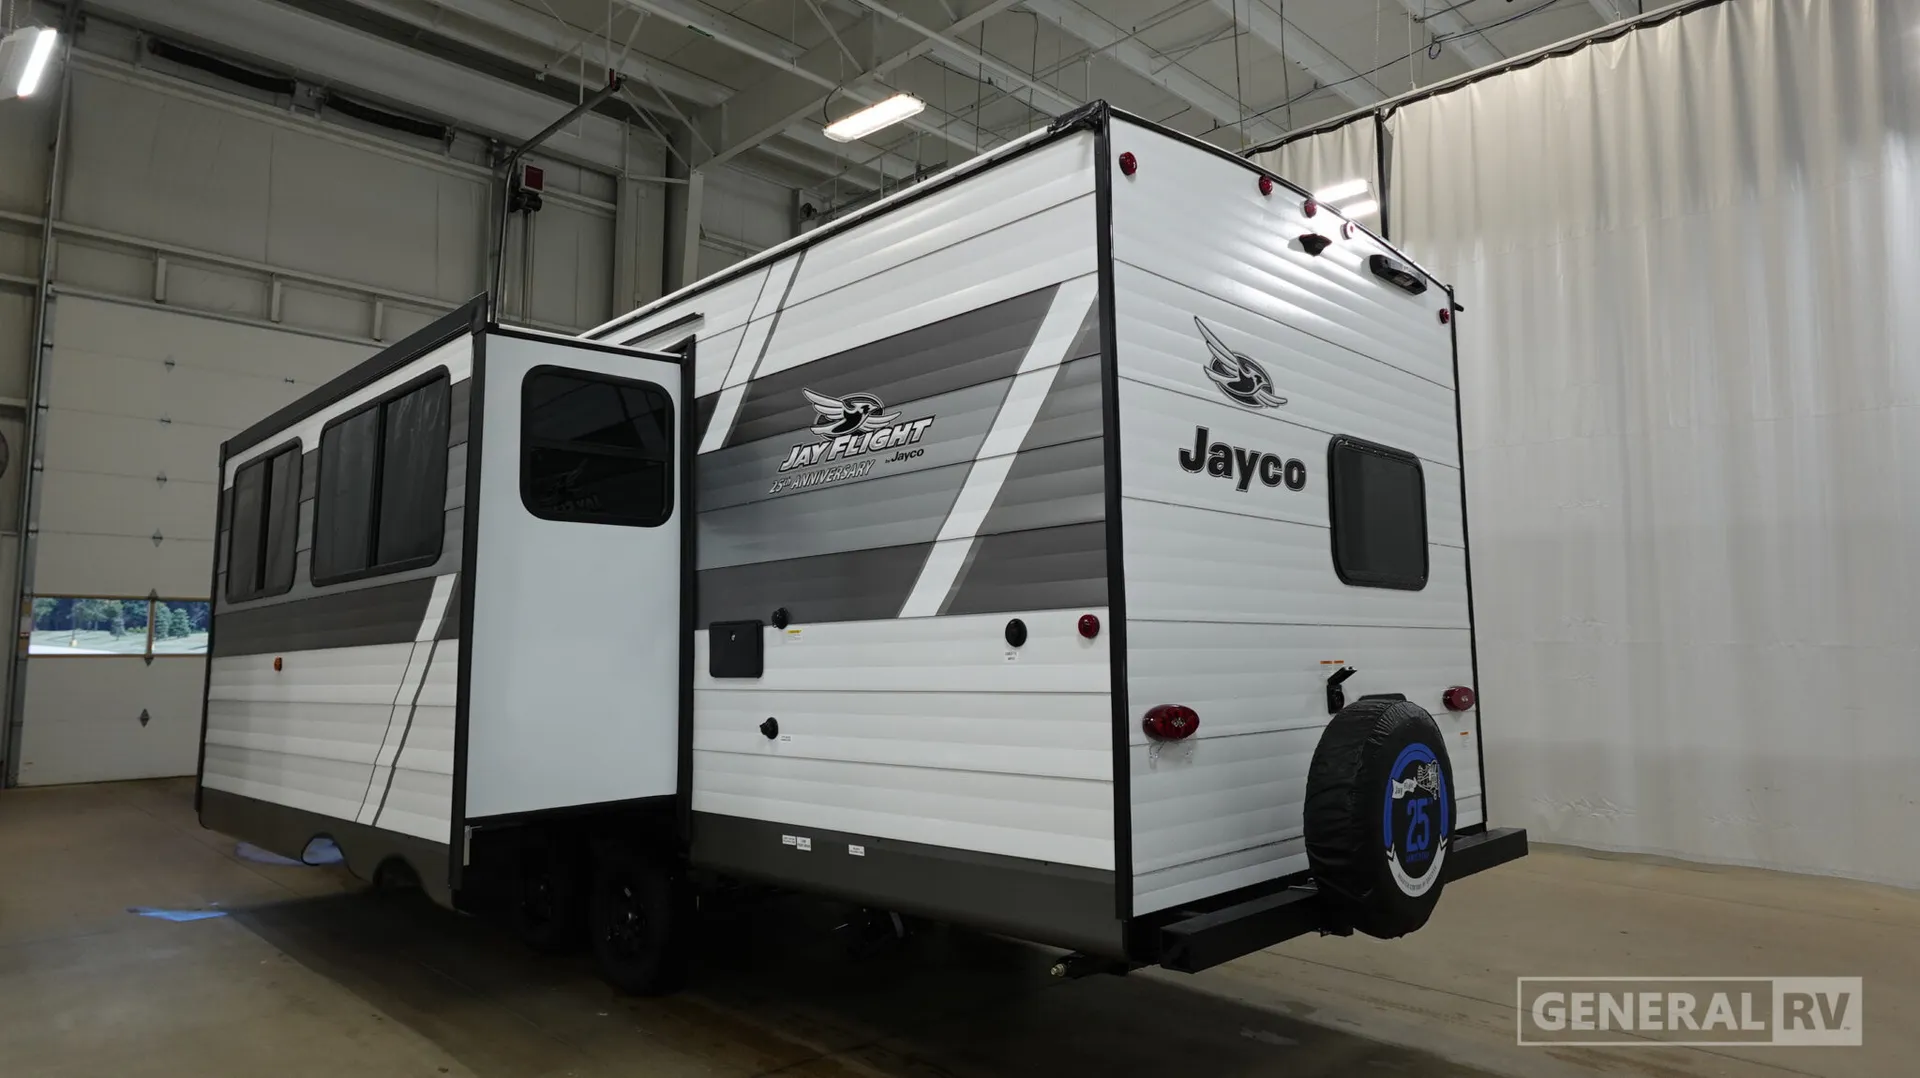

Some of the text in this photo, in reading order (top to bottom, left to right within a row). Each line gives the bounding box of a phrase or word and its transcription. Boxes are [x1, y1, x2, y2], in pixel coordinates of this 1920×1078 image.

[778, 414, 936, 472] JAY FLIGHT
[891, 448, 924, 463] Jayco
[1179, 425, 1306, 493] Jayco
[791, 458, 876, 490] ANNIVERSARY
